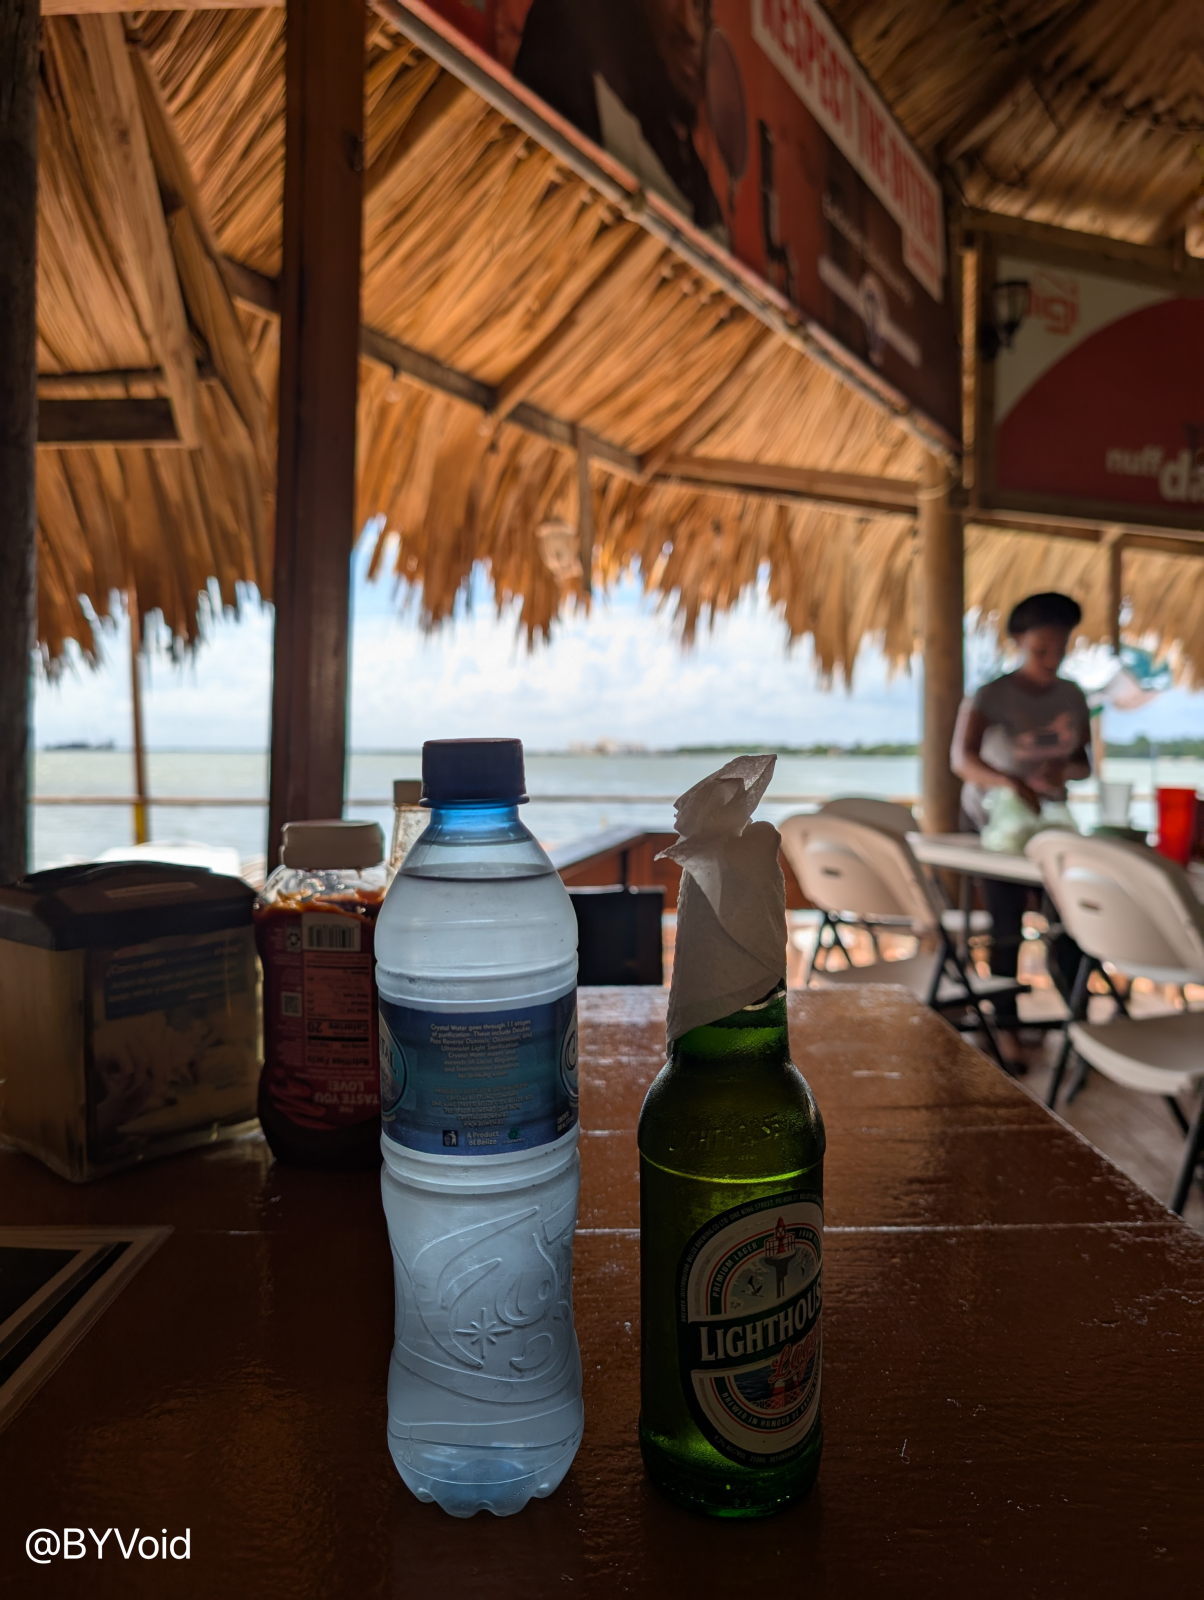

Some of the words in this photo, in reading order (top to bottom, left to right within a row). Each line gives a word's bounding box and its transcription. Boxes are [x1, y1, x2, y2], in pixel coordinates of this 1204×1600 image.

[1104, 443, 1165, 478] nuff
[312, 1092, 339, 1104] YOU
[342, 1093, 379, 1105] TASTE
[712, 1258, 735, 1298] PREMIUM
[734, 1241, 759, 1261] LAGER
